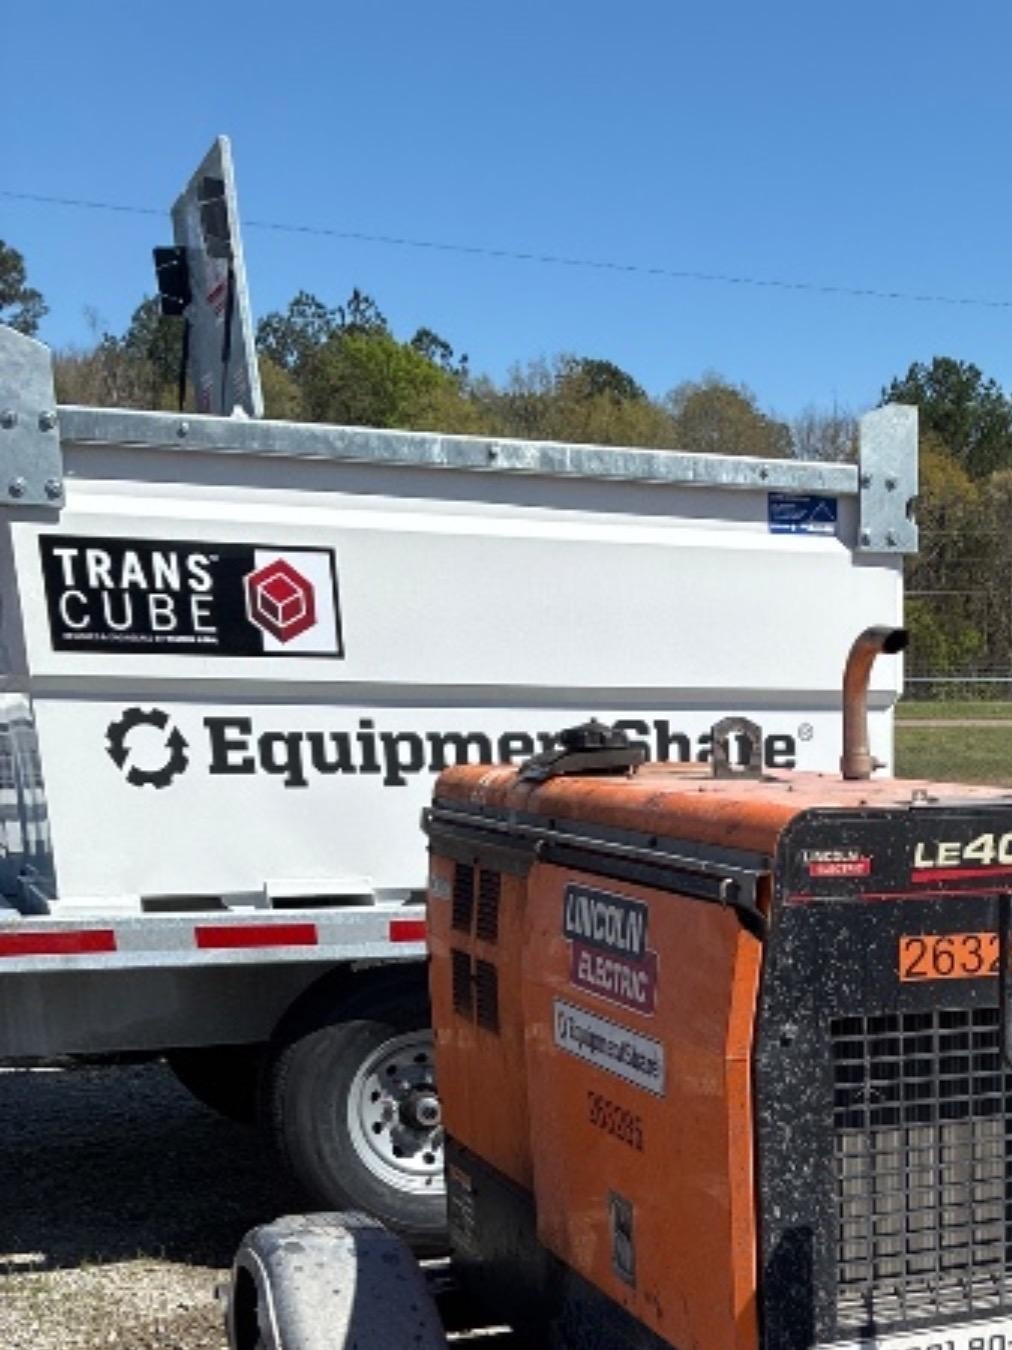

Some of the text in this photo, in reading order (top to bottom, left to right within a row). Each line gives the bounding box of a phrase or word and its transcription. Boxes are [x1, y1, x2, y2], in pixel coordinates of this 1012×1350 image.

[53, 548, 214, 592] TRANS
[59, 589, 218, 633] CUBE
[565, 893, 643, 955] LINCOLN
[578, 950, 649, 1003] ELECTRIC
